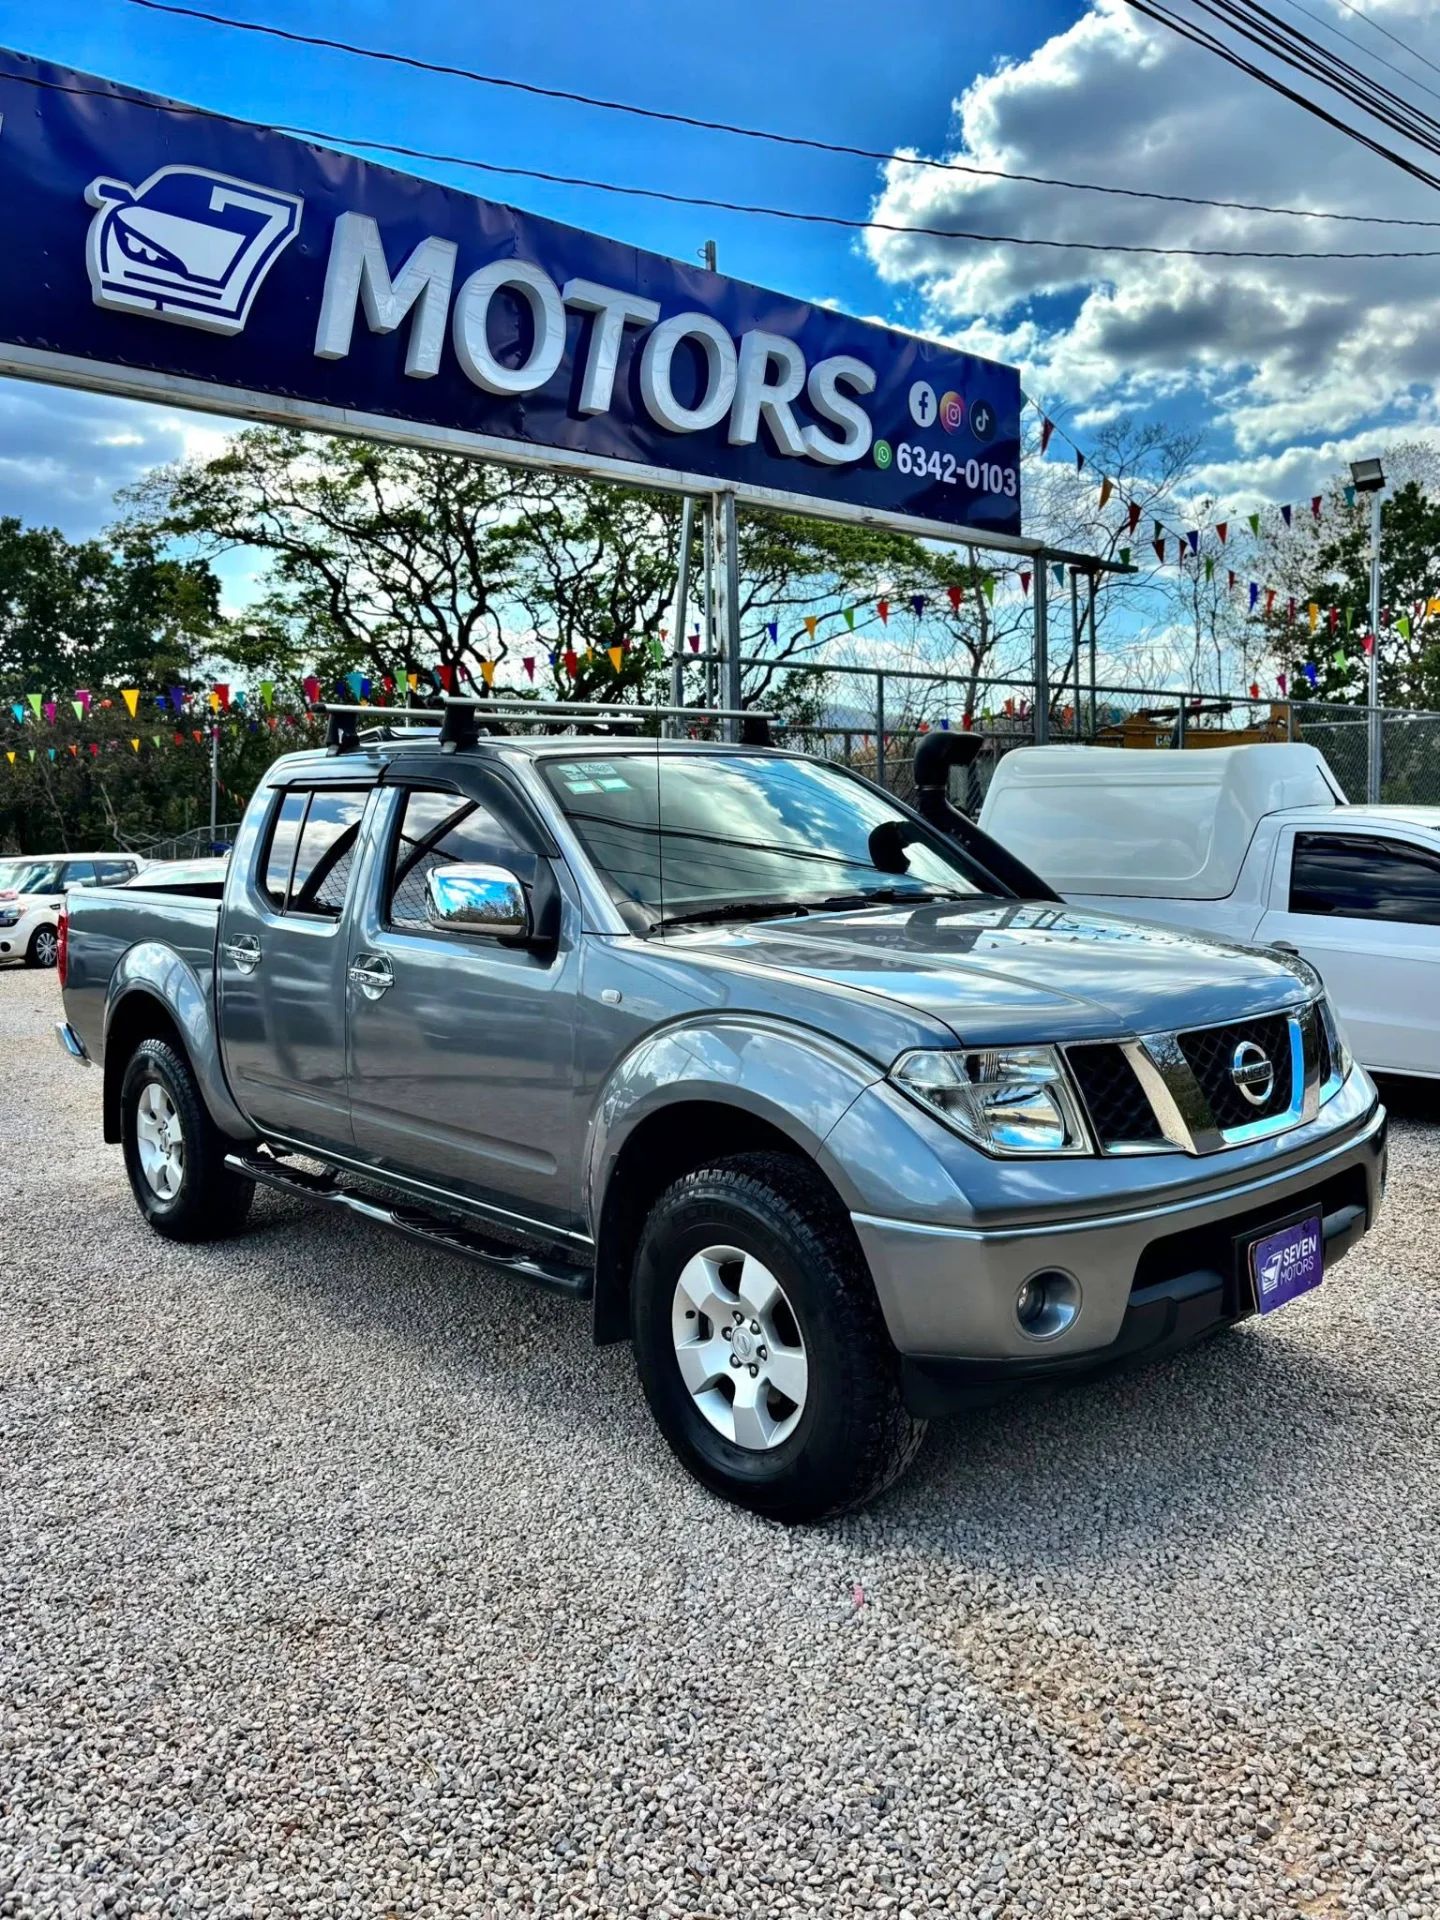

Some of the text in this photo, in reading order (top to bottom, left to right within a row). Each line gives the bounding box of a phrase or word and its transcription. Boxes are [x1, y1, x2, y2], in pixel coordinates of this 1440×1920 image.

[313, 211, 877, 466] MOTORS
[896, 442, 1017, 497] 6342-0103
[1280, 1255, 1314, 1286] MOTORS
[1283, 1234, 1317, 1267] SEVEN
